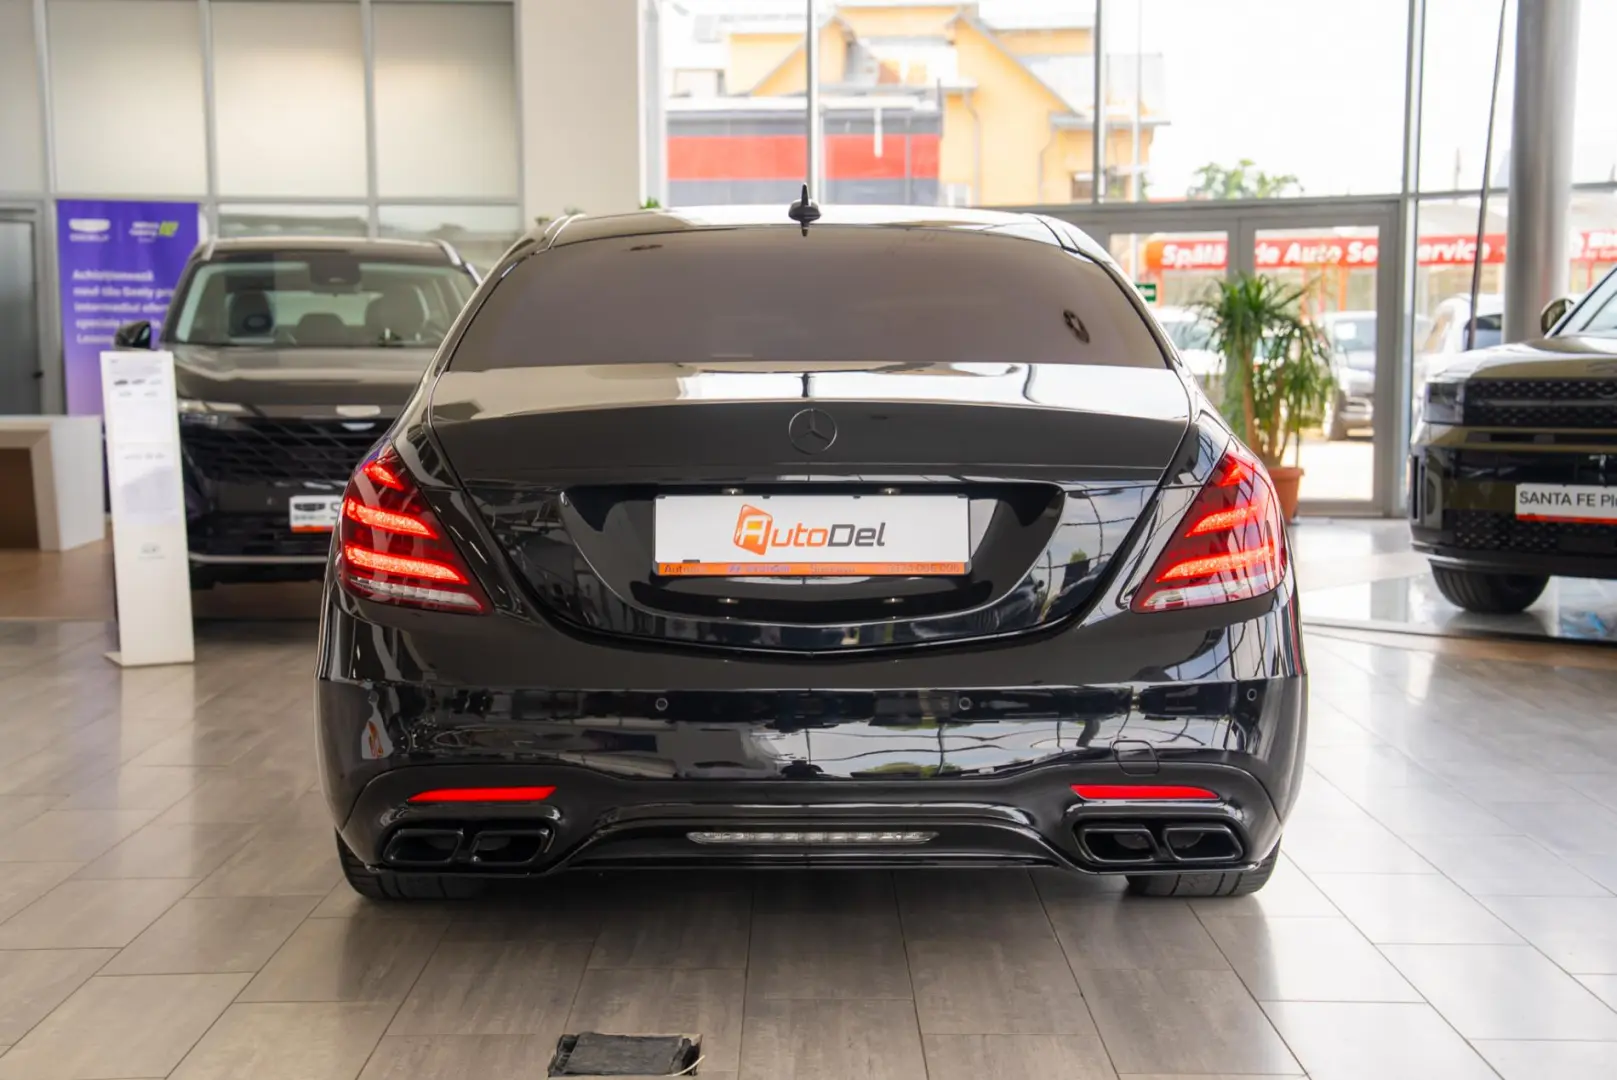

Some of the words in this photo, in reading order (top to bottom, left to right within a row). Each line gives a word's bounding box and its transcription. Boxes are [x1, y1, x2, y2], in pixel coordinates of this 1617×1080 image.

[1283, 241, 1343, 264] Auto
[1519, 491, 1572, 506] SANTA
[1577, 493, 1596, 507] FE
[738, 512, 886, 548] AutoDel
